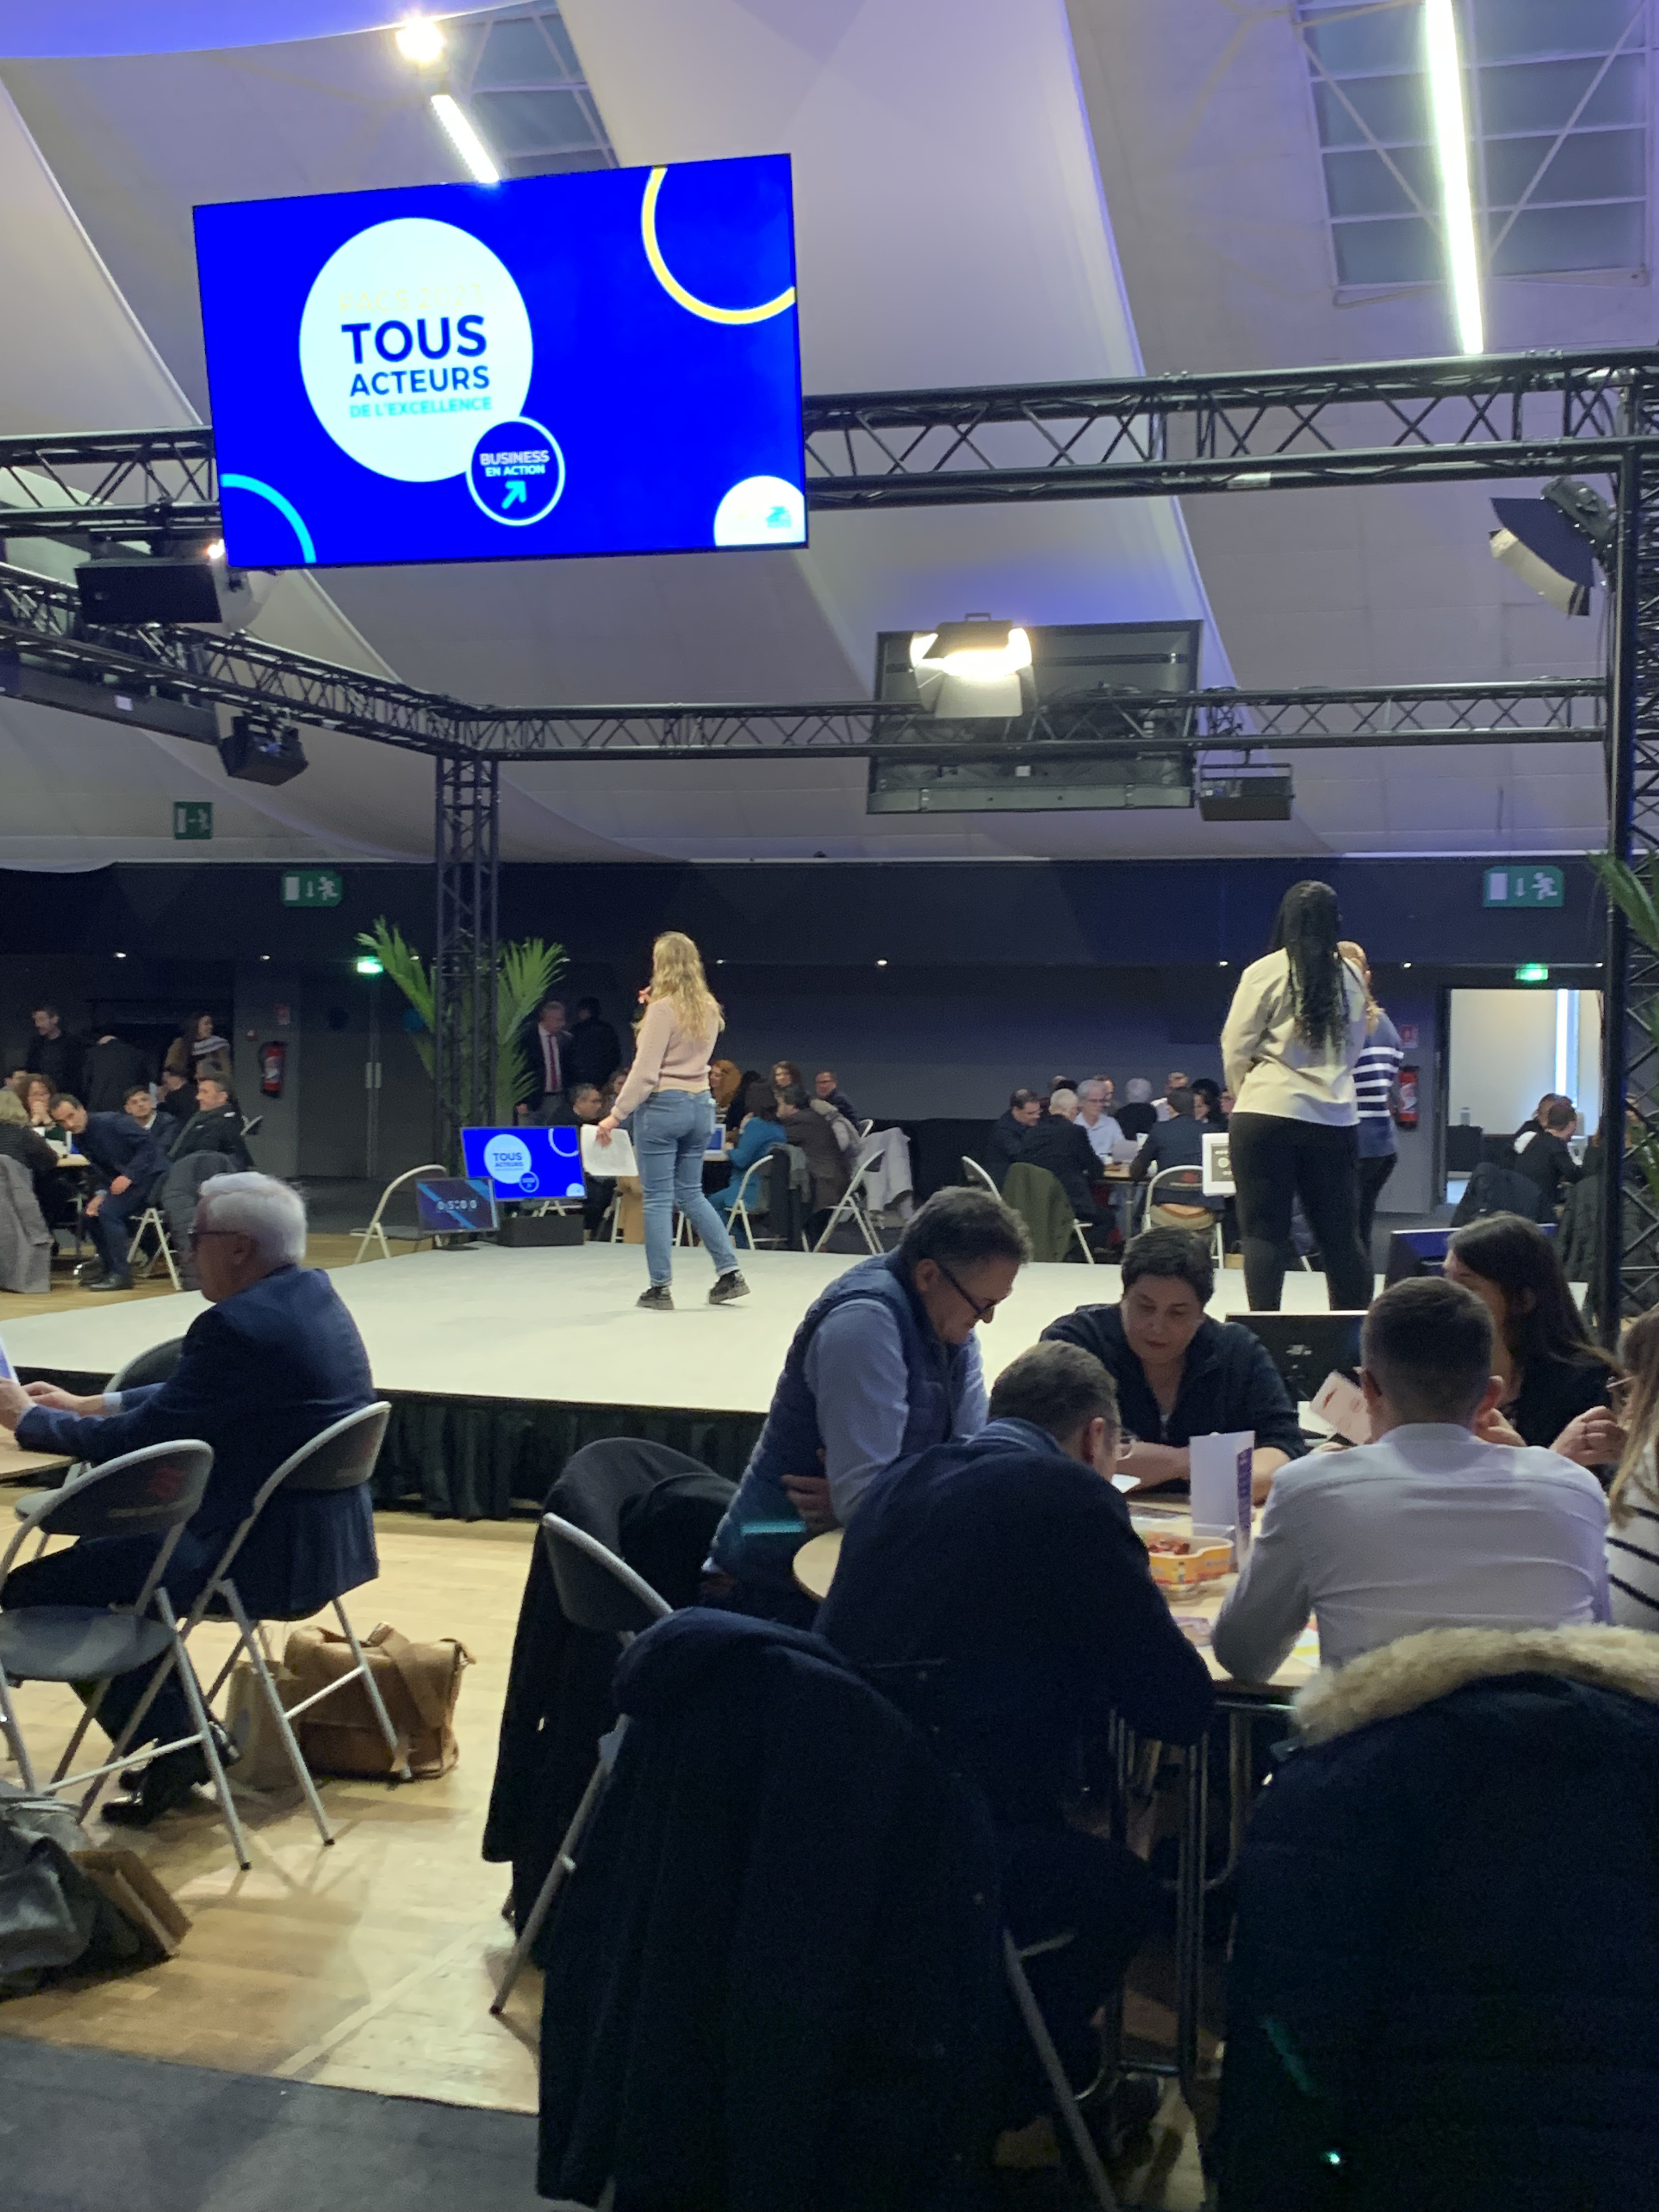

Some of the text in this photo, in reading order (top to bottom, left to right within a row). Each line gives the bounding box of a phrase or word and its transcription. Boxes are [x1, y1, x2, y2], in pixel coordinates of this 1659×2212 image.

[340, 284, 482, 313] PACS 2023
[341, 314, 487, 364] TOUS
[349, 365, 490, 397] ACTEURS
[349, 397, 492, 419] DE L'EXCELLENCE
[479, 450, 550, 465] BUSINESS
[485, 465, 545, 477] EN ACTION
[493, 1153, 522, 1161] TOUS
